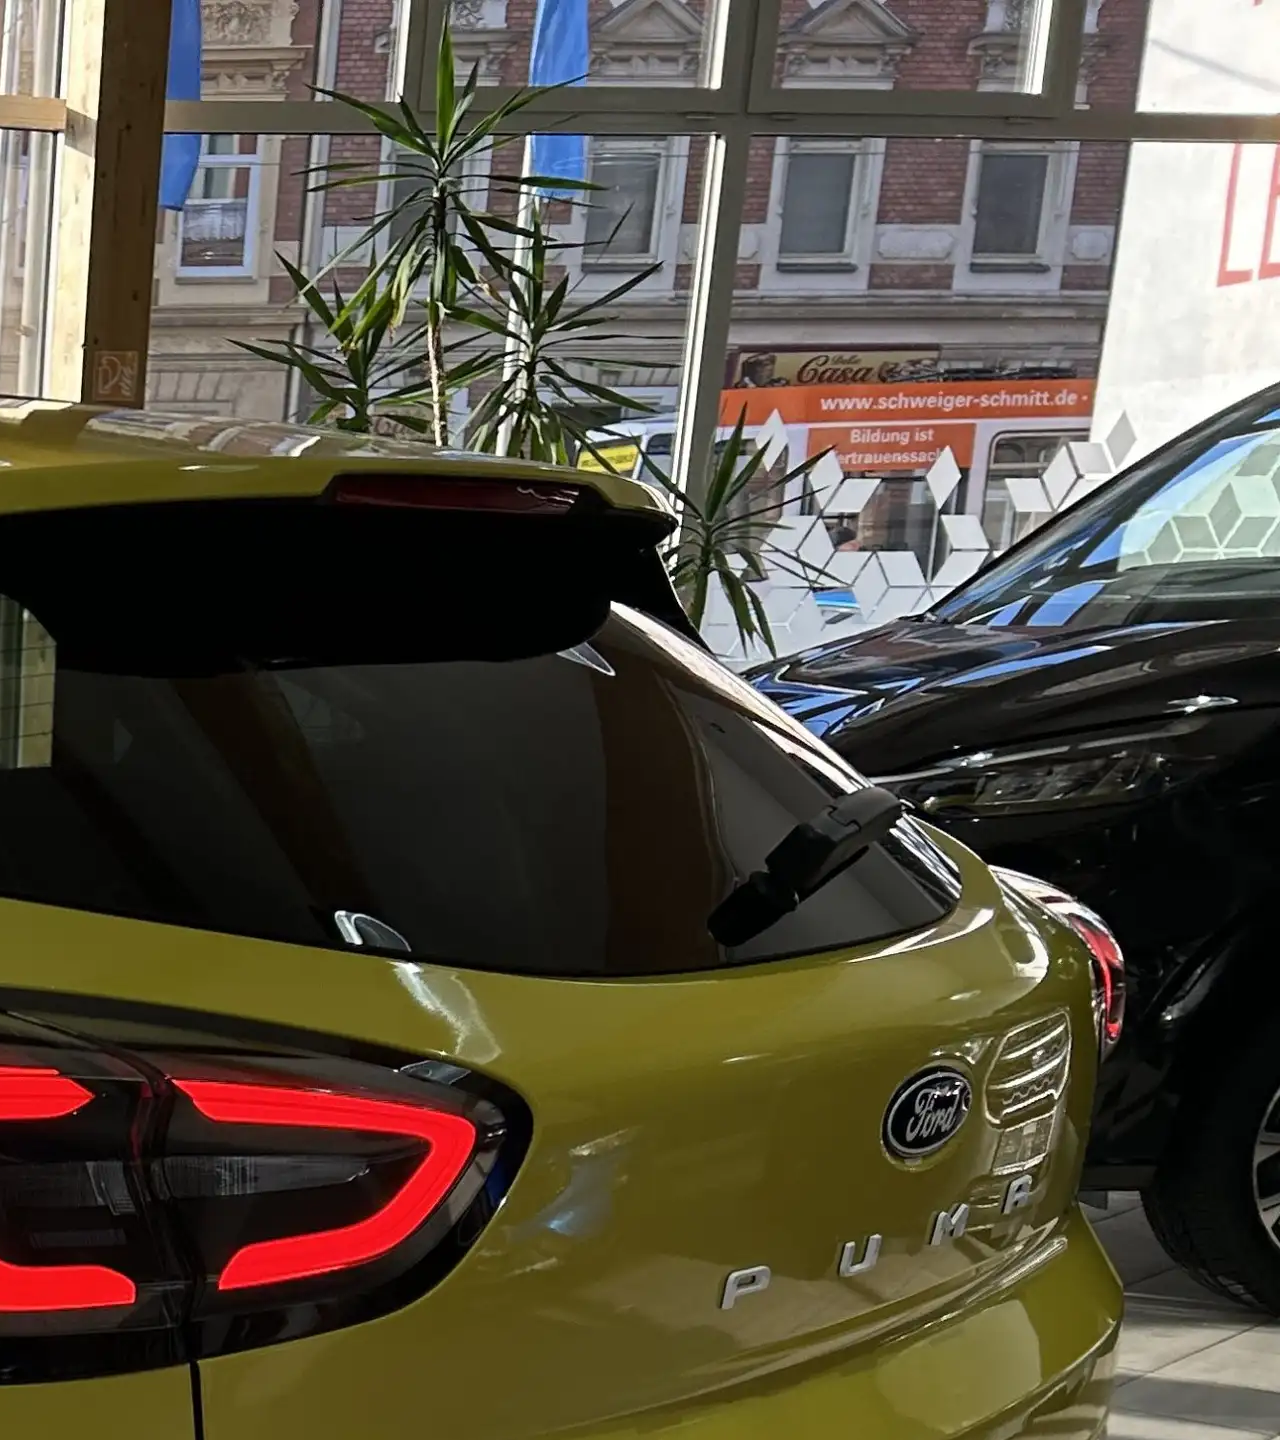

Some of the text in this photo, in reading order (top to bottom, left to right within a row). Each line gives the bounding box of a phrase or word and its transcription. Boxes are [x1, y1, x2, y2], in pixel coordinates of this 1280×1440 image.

[797, 354, 875, 384] Casa
[820, 388, 1078, 412] www.schweiger-schmitt.de
[850, 427, 935, 445] Bildung ist
[837, 447, 941, 465] ertrauenssac
[906, 1085, 961, 1142] Ford
[721, 1174, 1033, 1310] PUMA
